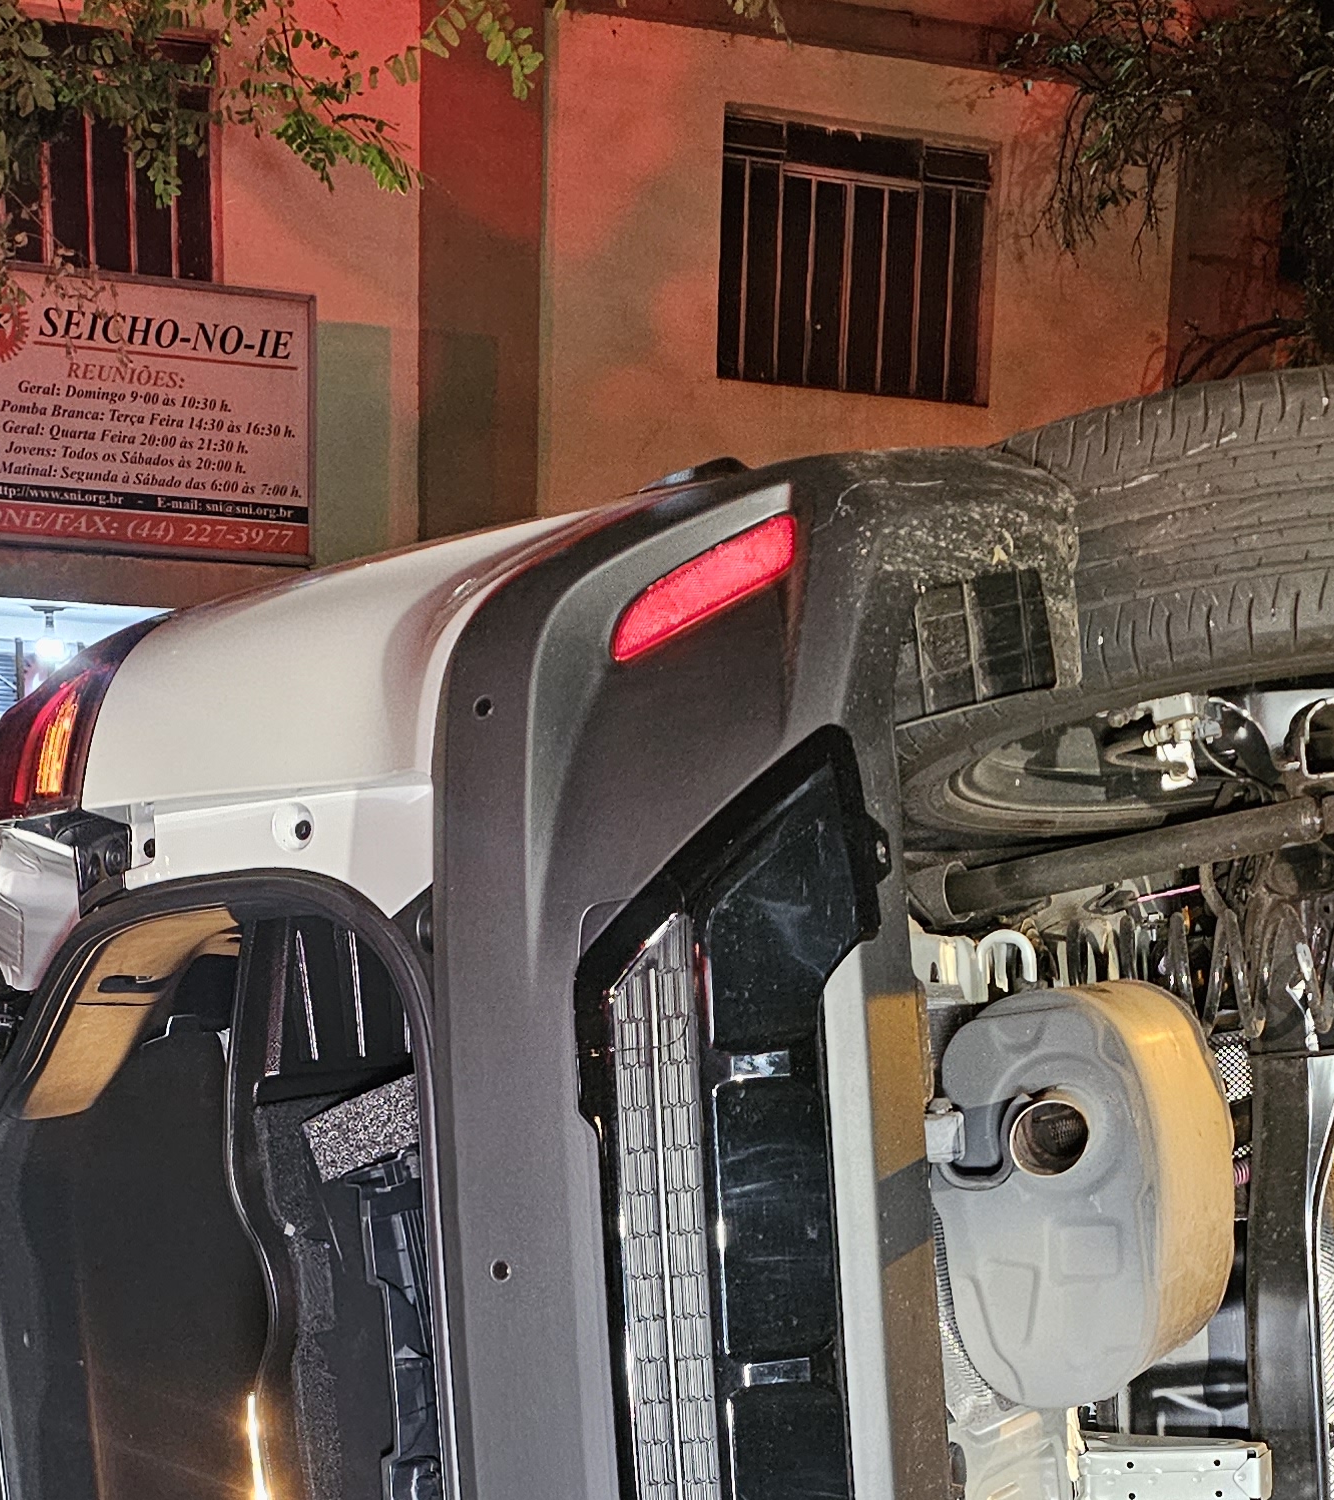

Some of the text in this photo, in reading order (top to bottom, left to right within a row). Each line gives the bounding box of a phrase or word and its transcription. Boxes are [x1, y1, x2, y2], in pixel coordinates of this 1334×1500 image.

[38, 305, 295, 361] SEICHO-NO-IE
[66, 361, 186, 390] REUNIÕES:
[17, 379, 61, 397] Geral:
[64, 384, 127, 405] Domingo
[161, 393, 177, 408] às
[180, 396, 217, 412] 10:30
[220, 399, 233, 413] h.
[0, 399, 48, 417] Pomba
[50, 404, 105, 422] Branca:
[108, 408, 145, 427] Terça
[149, 412, 184, 428] Feira
[188, 416, 224, 433] 14:30
[227, 420, 242, 434] às
[245, 422, 281, 437] 16:30
[283, 426, 296, 439] h.
[2, 419, 249, 454] Geral: Quarta Feira 20:00 às 21:30 h.
[4, 440, 246, 475] Jovens: Todos os Sábados às 20:00 h.
[60, 466, 118, 483] Segunda
[133, 471, 182, 489] Sábado
[184, 476, 207, 491] das
[210, 478, 239, 494] 6:00
[241, 481, 256, 495] às
[260, 483, 289, 498] 7:00
[290, 485, 303, 499] h.
[157, 496, 203, 512] E-mail:
[205, 502, 295, 520] sni@sni.org.br
[126, 519, 175, 543] (44)
[183, 522, 295, 547] 227-3977
